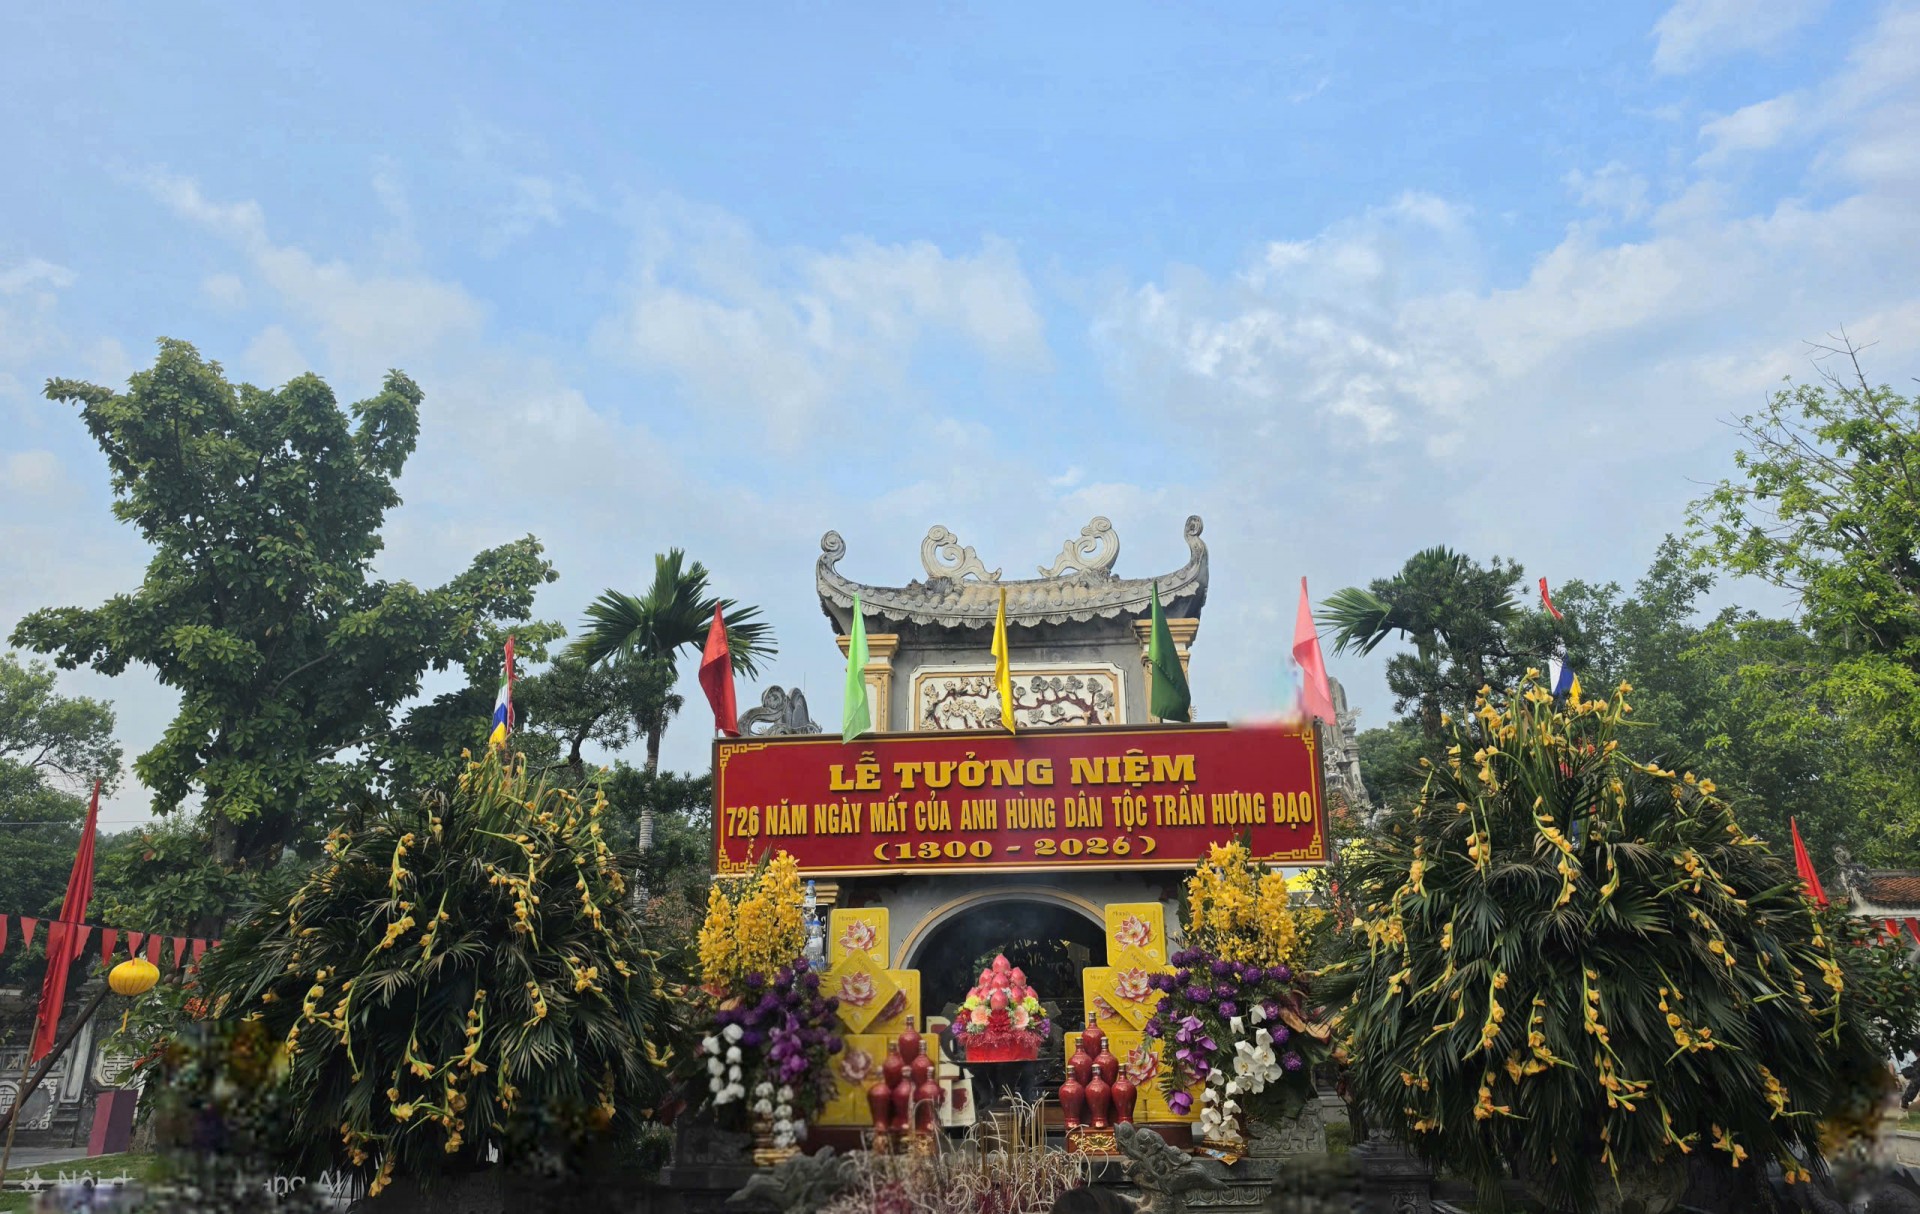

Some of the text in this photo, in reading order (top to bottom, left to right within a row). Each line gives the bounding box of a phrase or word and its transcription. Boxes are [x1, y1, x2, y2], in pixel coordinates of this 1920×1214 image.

[829, 748, 1197, 791] LỄ TƯỞNG NIỆM
[726, 784, 1312, 837] 726 NĂM NGÀY MẤT CỦA ANH HÙNG DÂN TỘC TRẦN HƯNG ĐẠO
